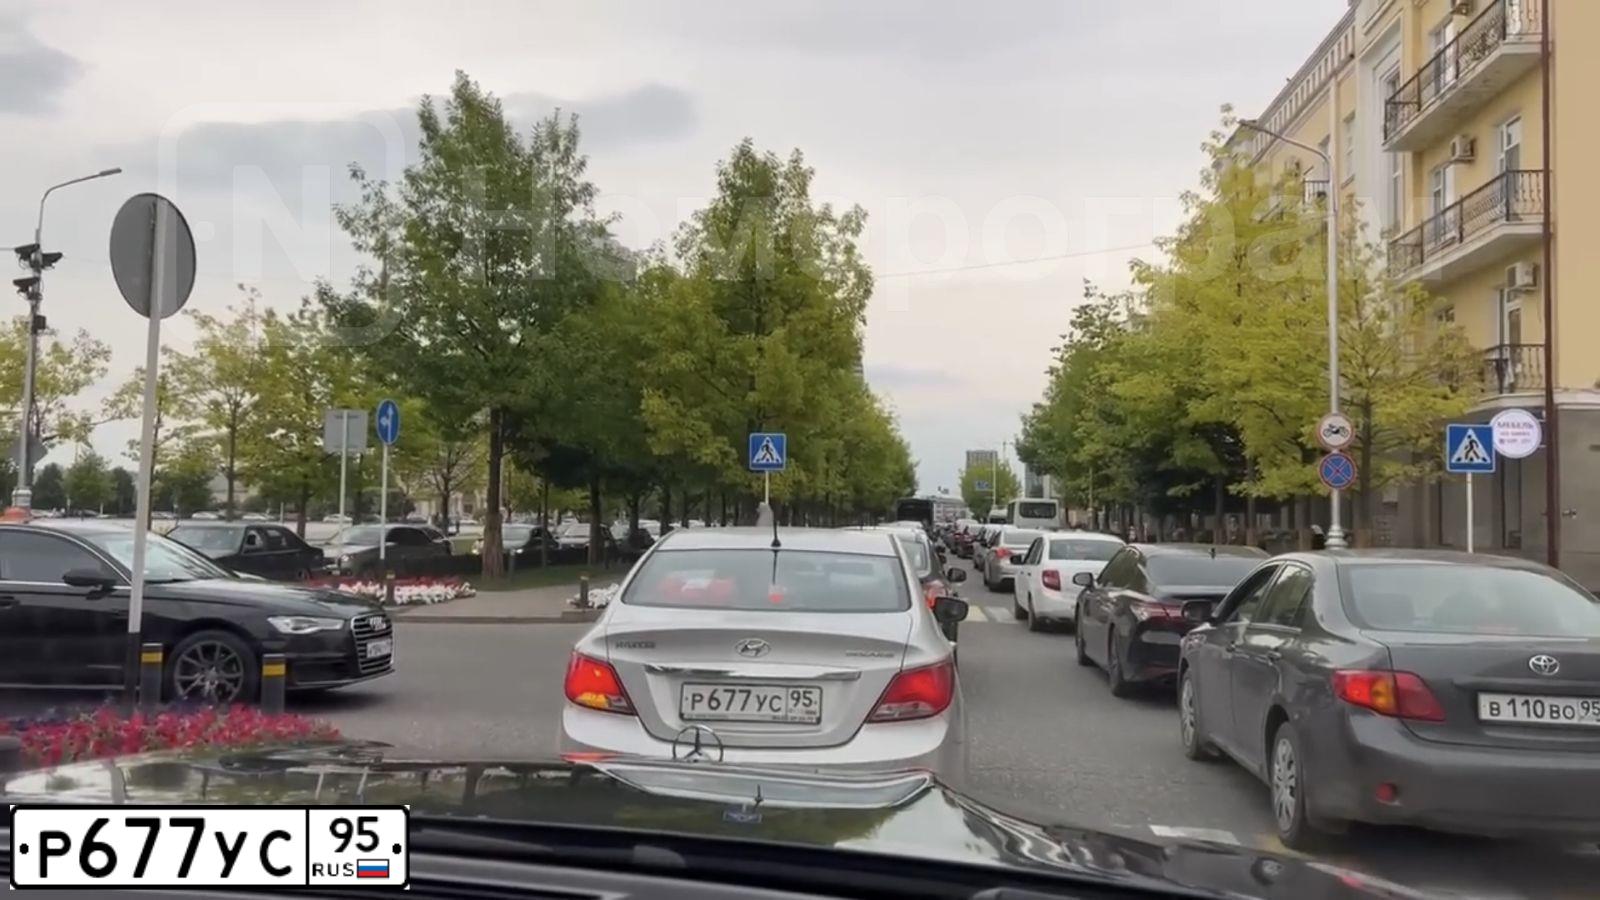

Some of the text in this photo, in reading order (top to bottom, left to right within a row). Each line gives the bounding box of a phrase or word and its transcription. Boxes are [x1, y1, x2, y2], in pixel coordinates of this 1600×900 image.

[691, 688, 813, 712] Р677УС 95
[1580, 700, 1600, 716] 95
